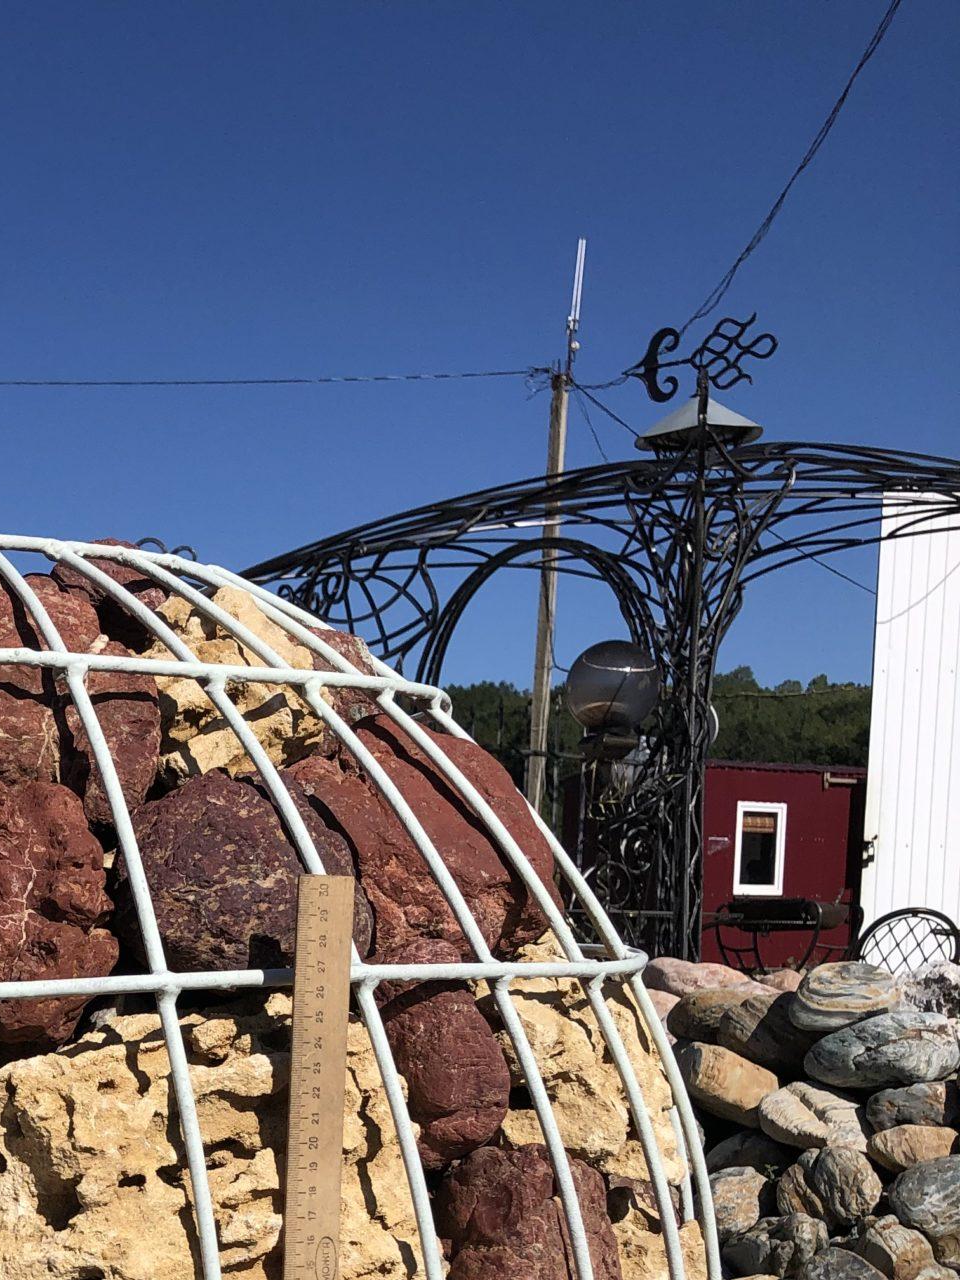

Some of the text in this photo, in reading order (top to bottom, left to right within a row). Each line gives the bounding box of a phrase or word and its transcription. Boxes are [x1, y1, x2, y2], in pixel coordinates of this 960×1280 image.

[318, 883, 329, 897] 30
[320, 909, 328, 922] 29
[319, 934, 327, 948] 28
[318, 961, 325, 973] 27
[315, 985, 325, 999] 26
[315, 1010, 323, 1023] 25
[315, 1036, 322, 1049] 24
[314, 1062, 321, 1074] 23
[312, 1086, 321, 1099] 22
[311, 1112, 320, 1125] 21
[308, 1136, 319, 1150] 20
[309, 1161, 318, 1173] 19
[308, 1186, 316, 1196] 18
[308, 1211, 316, 1221] 17
[307, 1235, 315, 1246] 16
